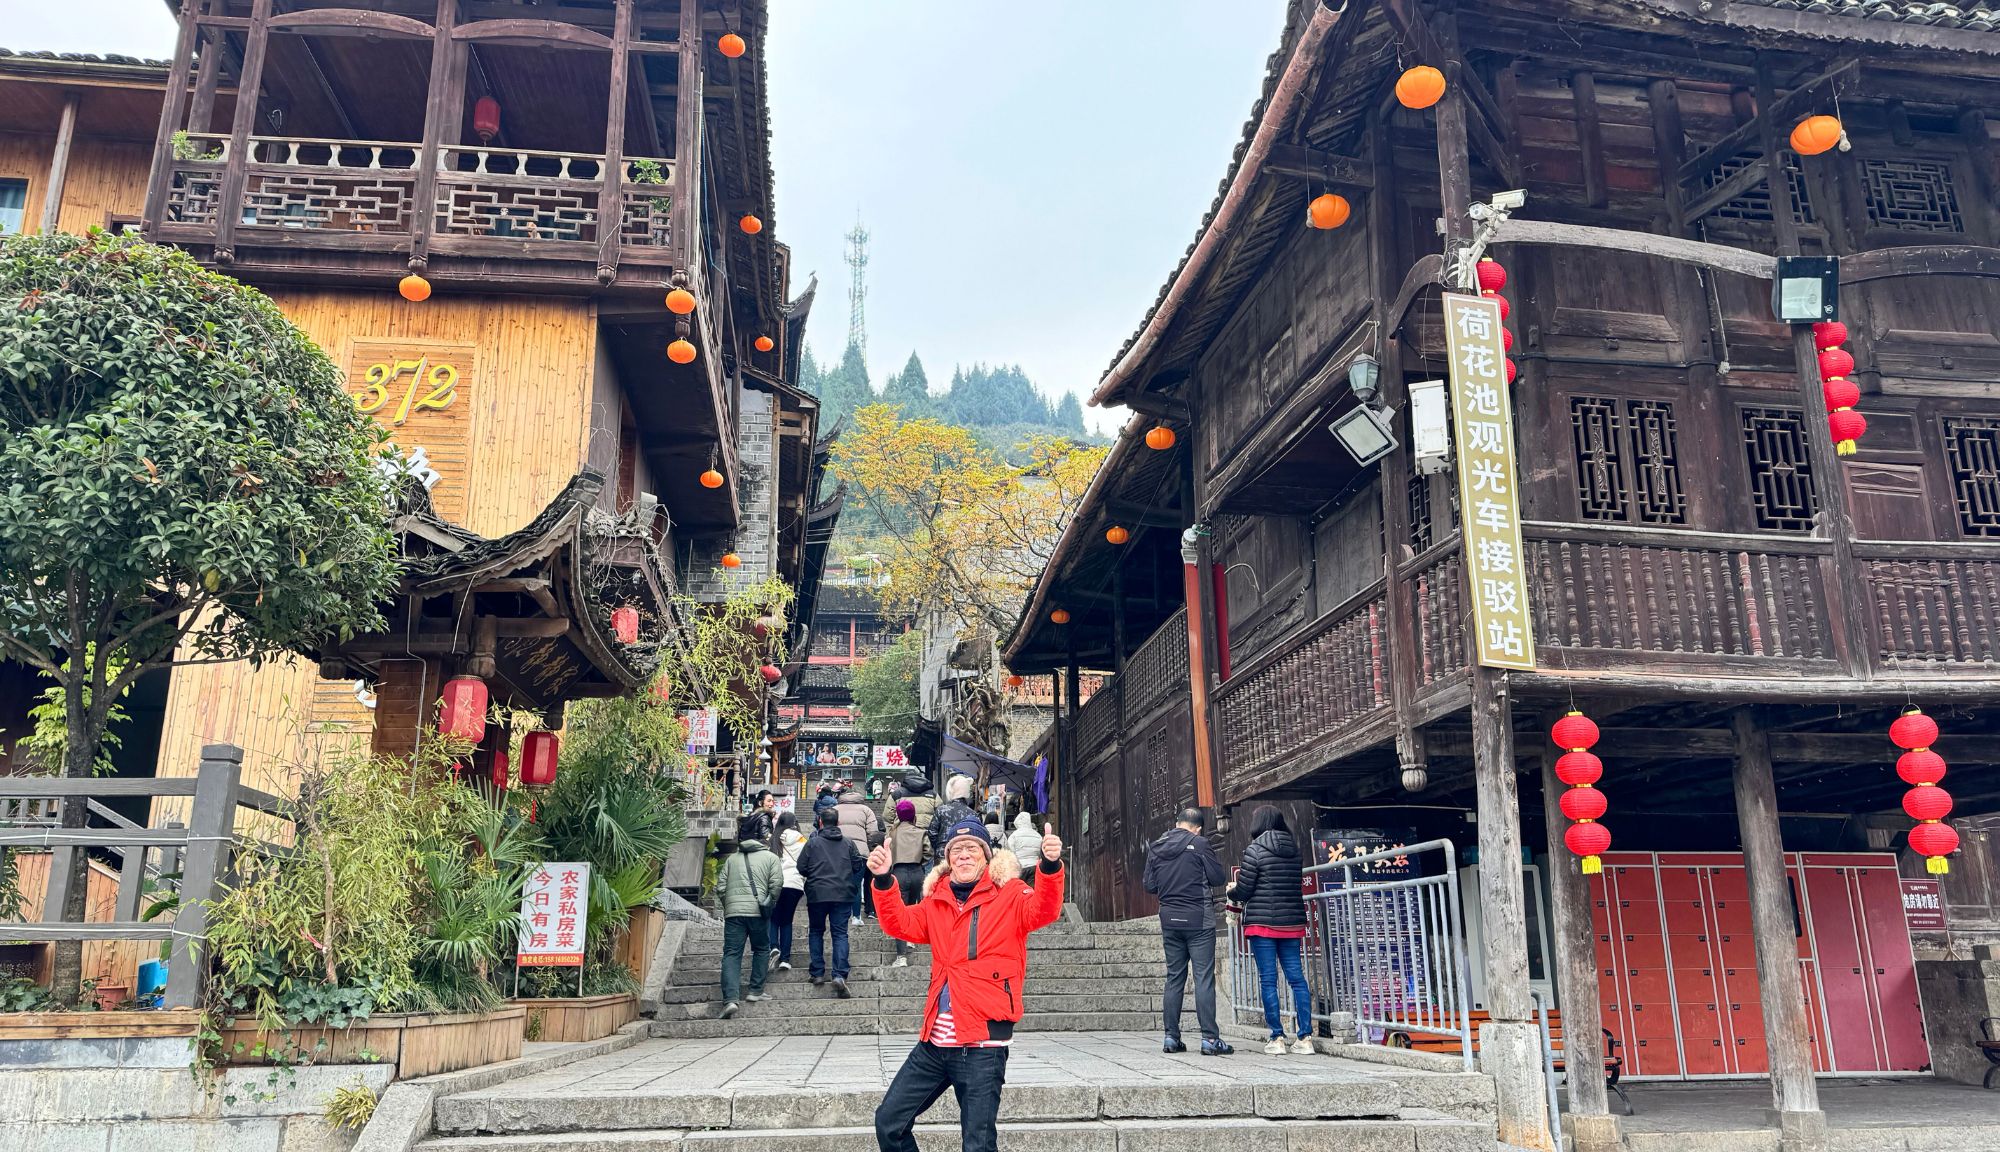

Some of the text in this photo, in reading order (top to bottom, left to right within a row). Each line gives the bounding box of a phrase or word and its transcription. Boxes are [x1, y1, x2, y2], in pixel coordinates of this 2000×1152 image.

[353, 355, 459, 426] 372
[1456, 306, 1524, 657] 荷花池观光车接驳站
[886, 748, 910, 767] 烧
[528, 871, 553, 948] 今日有房
[555, 870, 579, 948] 农家私房菜
